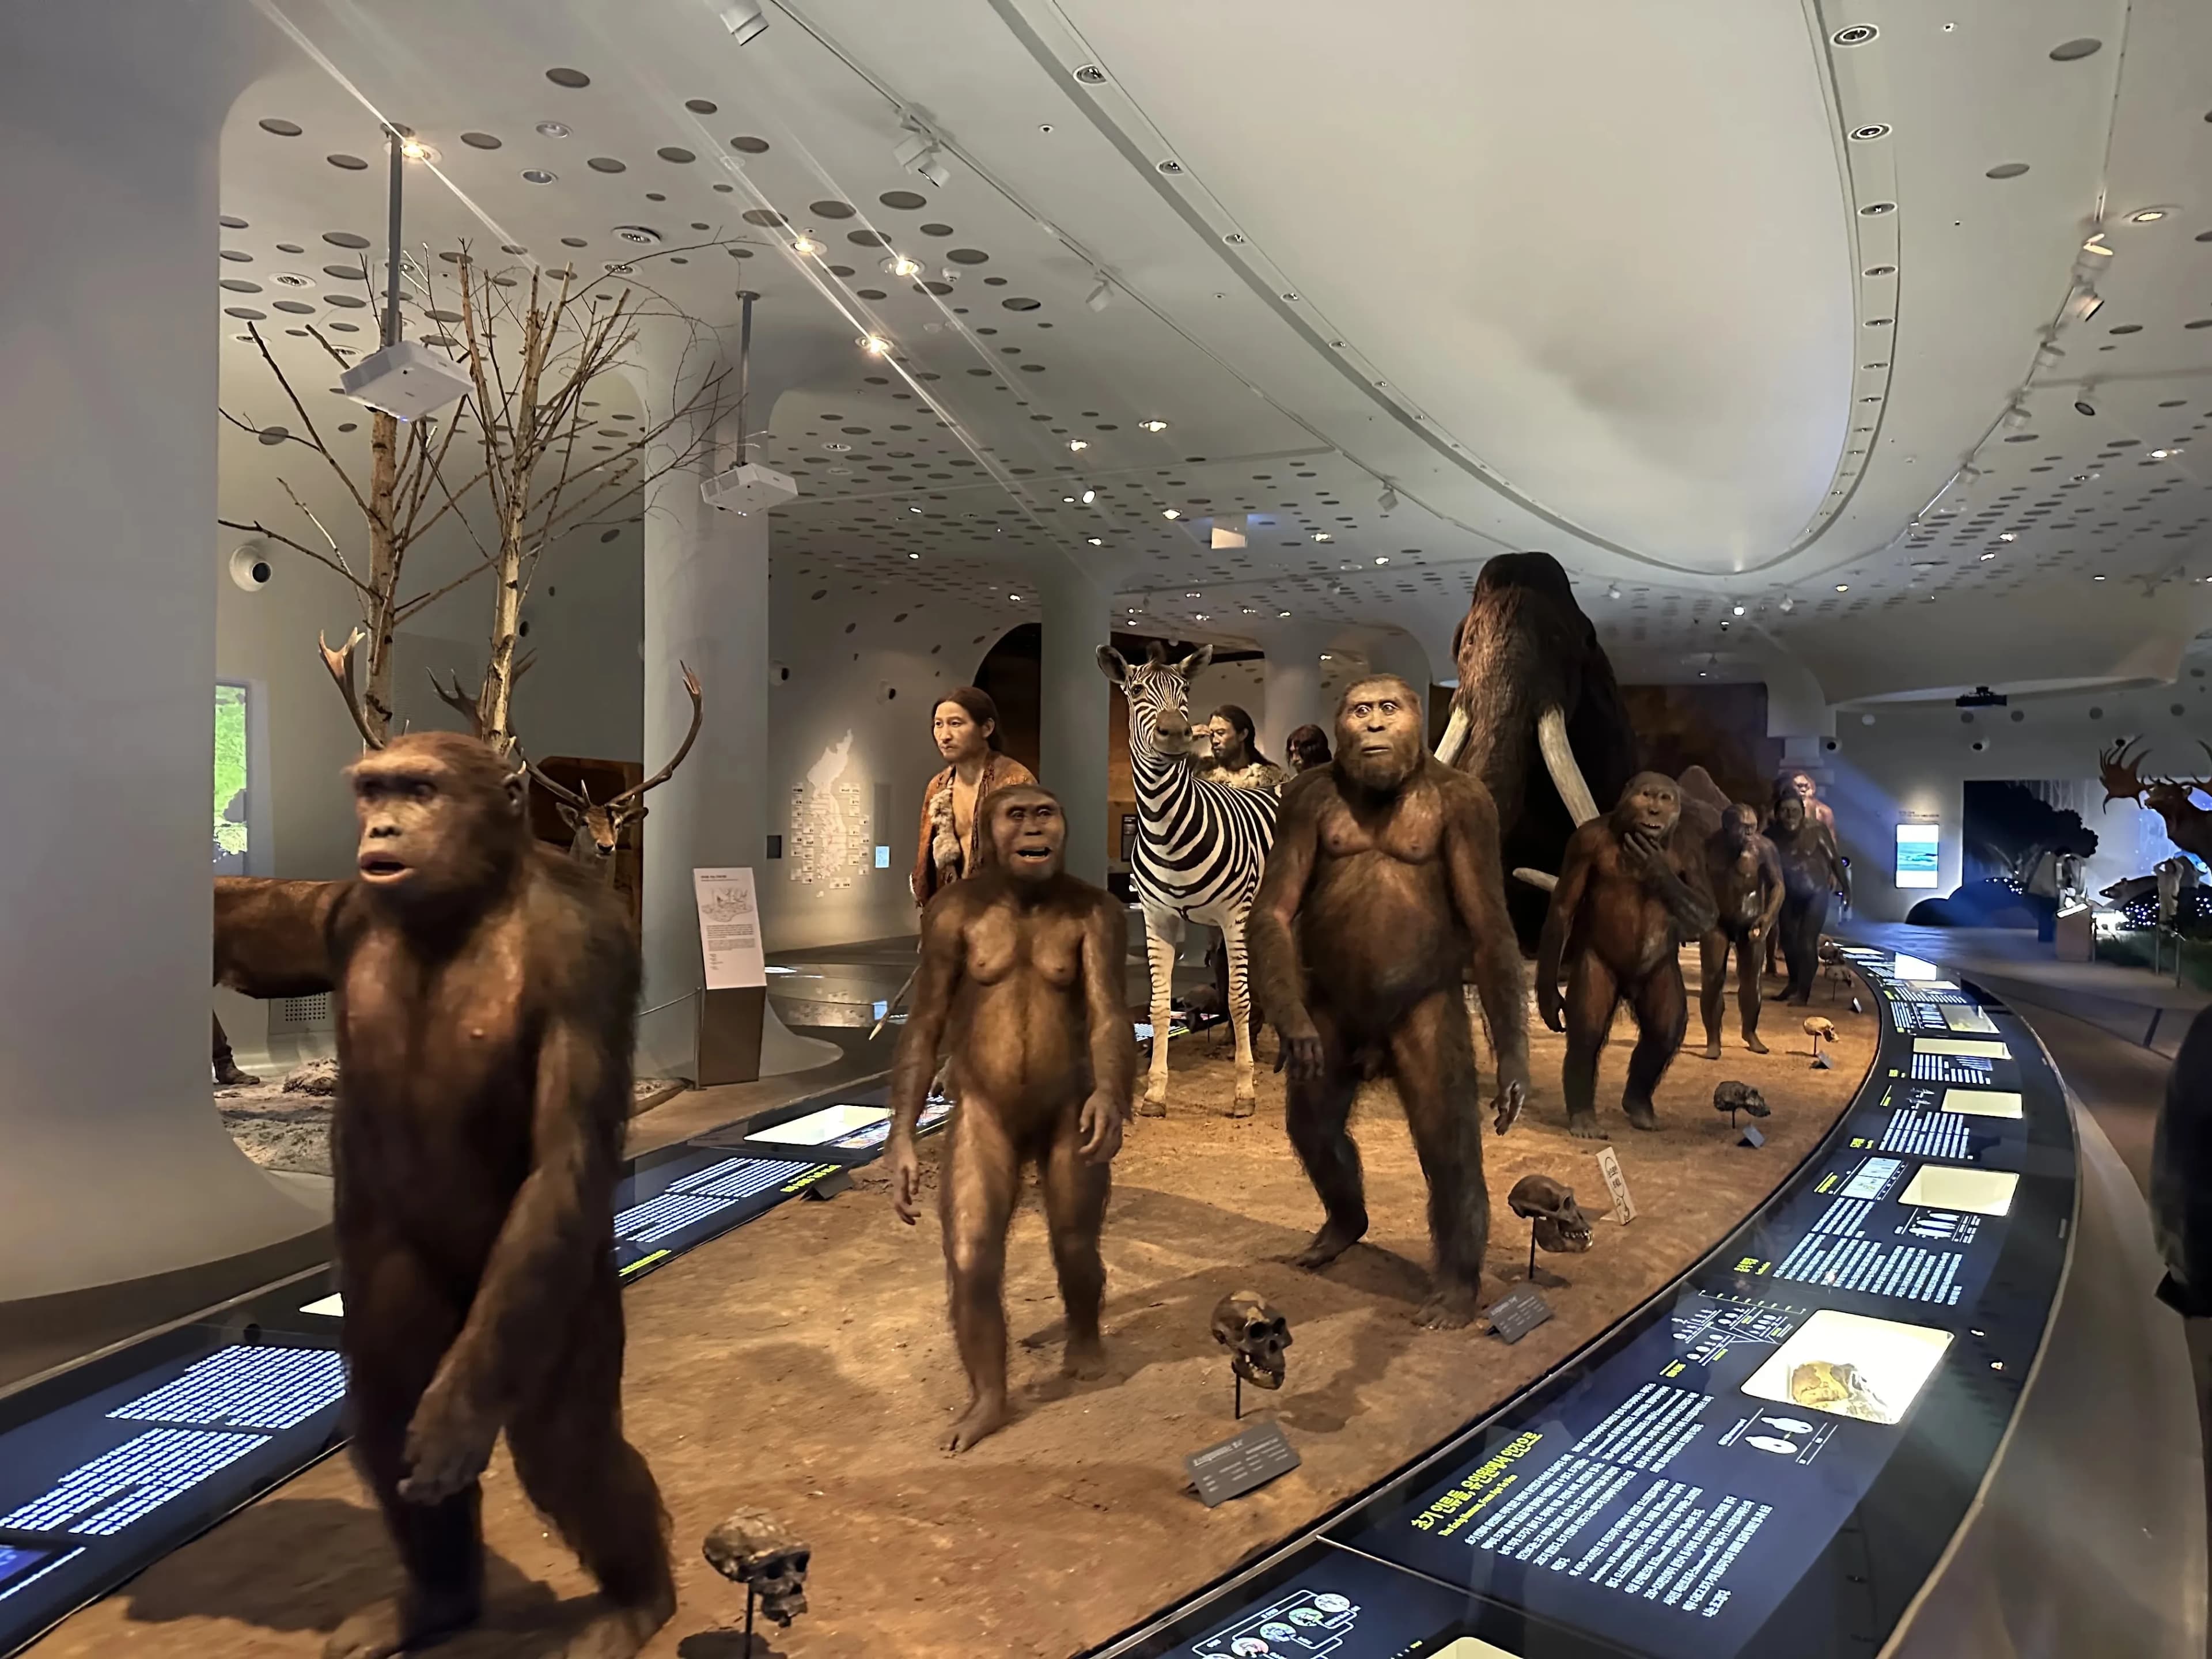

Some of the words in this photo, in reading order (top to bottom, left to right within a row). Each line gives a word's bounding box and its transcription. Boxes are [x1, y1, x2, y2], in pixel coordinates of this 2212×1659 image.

[1411, 1511, 1444, 1530] 초기
[1430, 1490, 1476, 1513] 인류들,
[1461, 1455, 1514, 1490] 유인원에서
[1501, 1431, 1543, 1457] 인간으로
[1438, 1527, 1455, 1536] The
